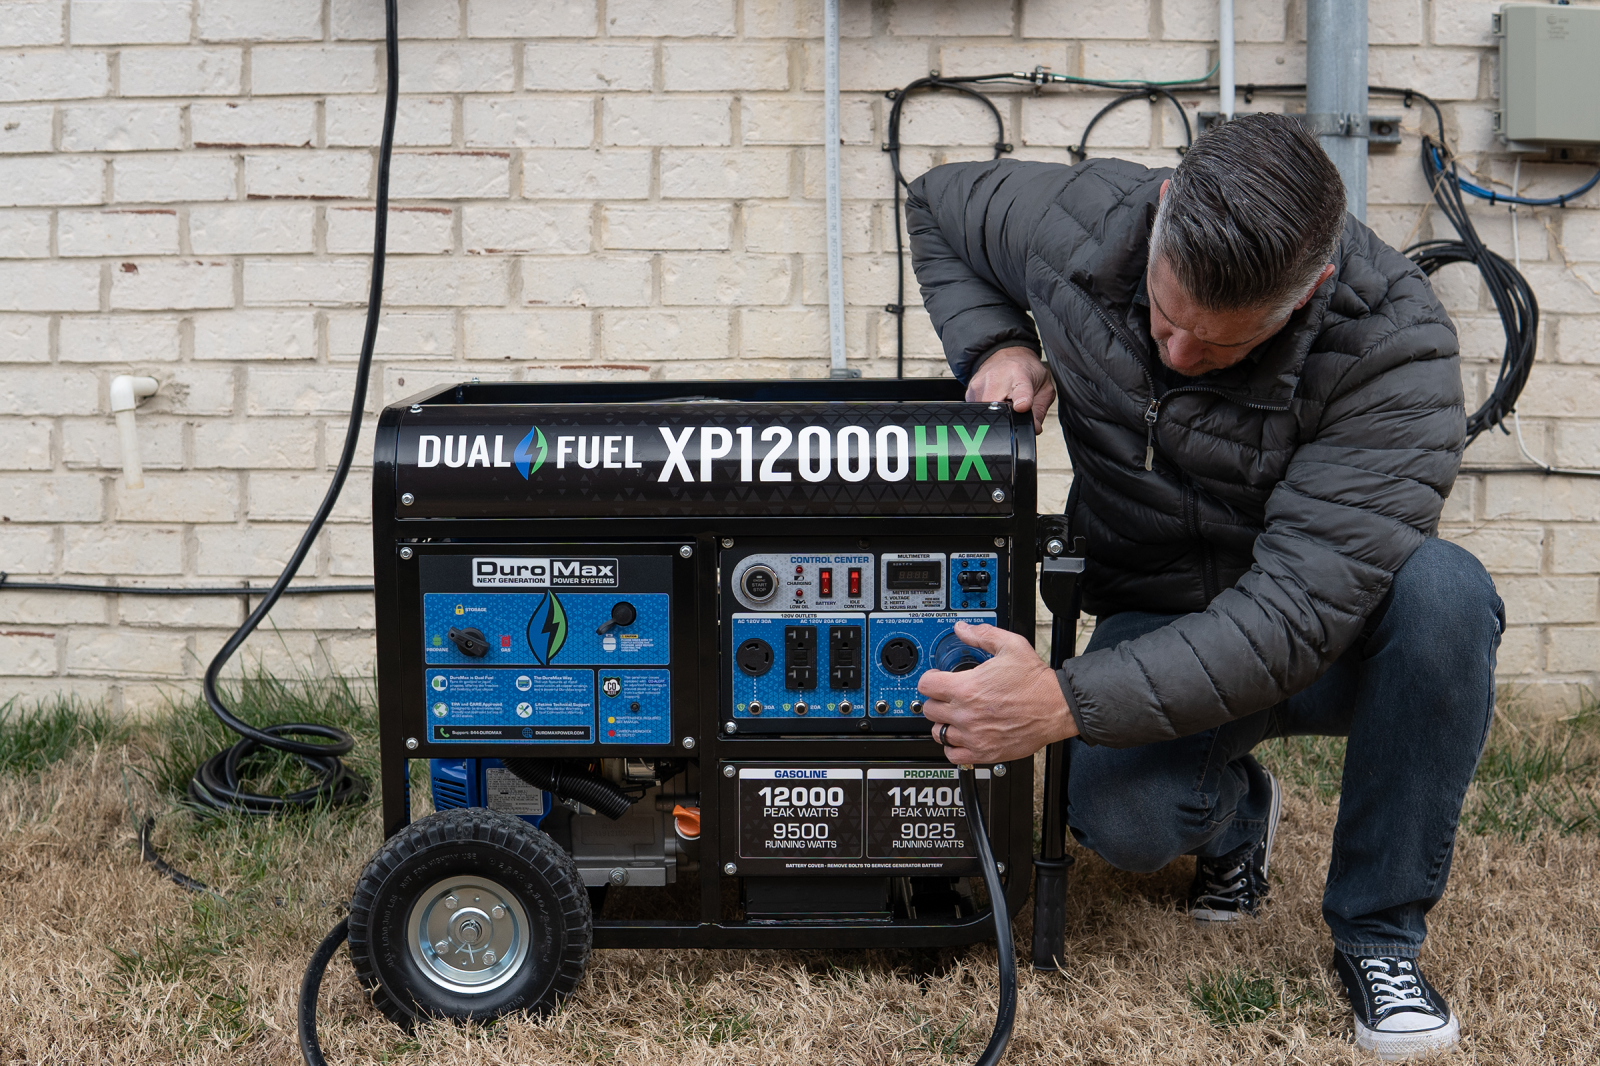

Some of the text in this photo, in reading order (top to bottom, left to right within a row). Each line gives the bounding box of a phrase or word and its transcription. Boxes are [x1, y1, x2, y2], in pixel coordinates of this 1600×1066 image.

[418, 424, 992, 482] DUAL FUEL XP12000HX
[476, 562, 614, 576] Duro Max
[607, 682, 616, 691] CO
[758, 787, 844, 806] 12000
[764, 808, 838, 817] PEAK WATTS
[892, 808, 966, 817] PEAK WATTS
[773, 823, 829, 838] 9500
[901, 823, 955, 838] 9025
[765, 840, 837, 848] RUNNING WATTS
[892, 840, 964, 848] RUNNING WATTS
[400, 875, 413, 889] NOT
[413, 864, 428, 876] FOR
[428, 852, 459, 869] HIGHWAY
[382, 909, 392, 925] 300
[387, 893, 398, 908] LBS
